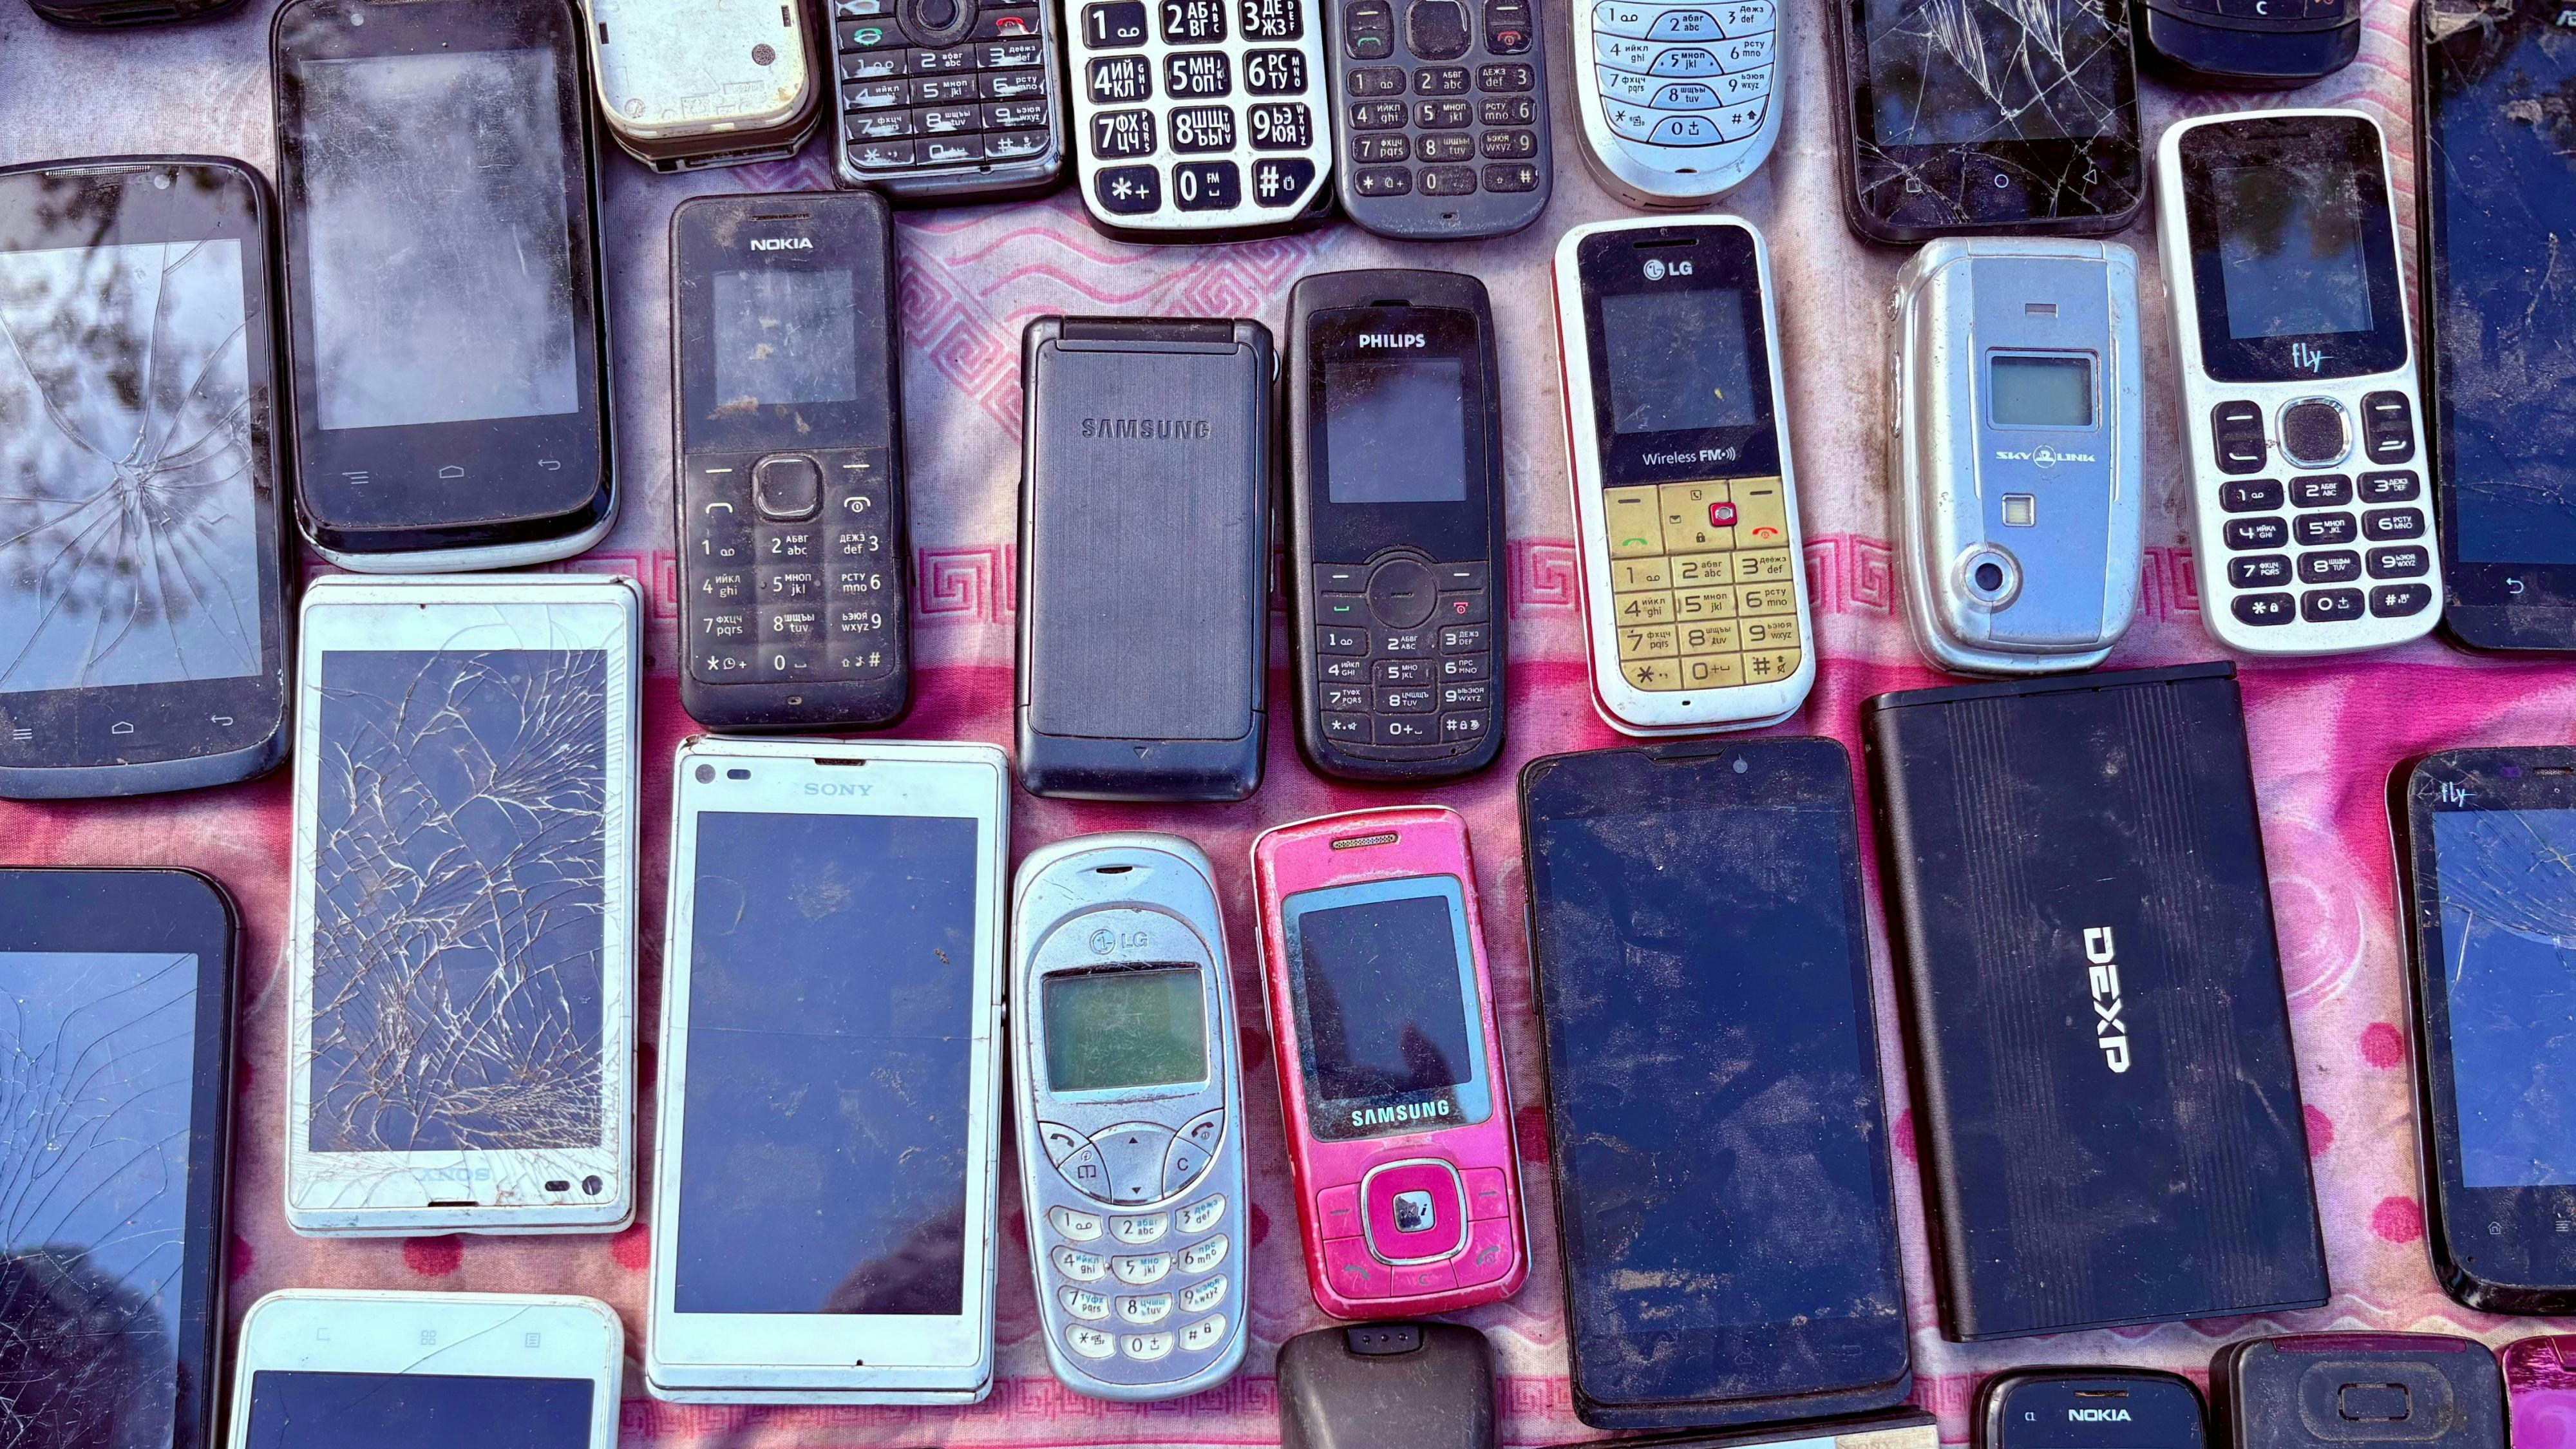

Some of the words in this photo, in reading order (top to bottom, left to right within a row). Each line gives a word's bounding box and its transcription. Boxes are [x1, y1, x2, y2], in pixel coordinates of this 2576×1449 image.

[2256, 1, 2268, 15] C
[1167, 5, 1184, 34] 2
[1244, 3, 1260, 31] 3
[1728, 12, 1736, 24] 3
[1741, 14, 1754, 24] def
[1093, 10, 1106, 39] 1
[1671, 18, 1680, 32] 2
[1684, 23, 1700, 32] abc
[1610, 43, 1621, 57] 4
[1730, 46, 1739, 60] 6
[920, 53, 936, 68] 2
[1631, 53, 1645, 63] ghi
[1671, 54, 1679, 68] 5
[1685, 60, 1697, 70] jkl
[1172, 61, 1188, 90] 5
[1249, 57, 1265, 86] 6
[1517, 69, 1527, 85] 3
[1094, 66, 1112, 95] 4
[1421, 73, 1431, 89] 2
[1444, 80, 1462, 90] abc
[1486, 77, 1503, 86] def
[1610, 74, 1619, 88] 7
[1728, 79, 1738, 92] 9
[923, 83, 938, 98] 5
[1669, 89, 1679, 102] 8
[1357, 107, 1367, 122] 4
[1485, 111, 1509, 120] mno
[1519, 102, 1529, 118] 6
[1253, 110, 1271, 140] 9
[1381, 113, 1398, 124] ghi
[1099, 118, 1114, 148] 7
[1176, 115, 1193, 144] 8
[1671, 122, 1683, 135] 0
[1426, 140, 1435, 156] 8
[1520, 135, 1529, 151] 9
[1380, 147, 1403, 158] pqrs
[1207, 173, 1220, 184] FM
[1426, 174, 1436, 189] 0
[1180, 171, 1197, 201] 0
[750, 237, 813, 251] NOKIA
[1668, 261, 1693, 276] LG
[1359, 334, 1425, 348] PHILIPS
[1082, 419, 1211, 440] SAMSUNG
[1642, 453, 1697, 466] Wireless
[1699, 449, 1722, 462] FM
[1996, 451, 2031, 460] SKY
[2057, 453, 2096, 462] LINK
[2306, 484, 2319, 497] 2
[2239, 527, 2255, 539] 4
[2309, 522, 2324, 535] 5
[772, 538, 782, 553] 2
[844, 544, 863, 554] def
[869, 536, 879, 551] 3
[787, 546, 807, 556] abc
[1682, 562, 1699, 579] 2
[1704, 569, 1721, 577] abc
[1742, 558, 1758, 574] 3
[1767, 564, 1783, 574] def
[2243, 565, 2255, 577] 7
[2313, 560, 2328, 573] 8
[703, 579, 713, 594] 4
[773, 577, 782, 592] 5
[842, 583, 867, 593] mno
[870, 574, 880, 589] 6
[791, 583, 806, 596] jkl
[1685, 596, 1701, 612] 5
[1746, 591, 1762, 608] 6
[1767, 598, 1788, 606] mno
[2317, 598, 2333, 611] 0
[1625, 600, 1641, 617] 4
[1647, 606, 1662, 616] ghi
[1710, 601, 1723, 613] jkl
[703, 618, 714, 633] 7
[773, 616, 784, 632] 8
[842, 622, 869, 632] wxyz
[871, 614, 882, 629] 9
[717, 625, 743, 636] pqrs
[1689, 629, 1705, 646] 8
[1749, 625, 1766, 641] 9
[1388, 638, 1399, 650] 2
[1445, 634, 1456, 645] 3
[1627, 634, 1643, 651] 7
[775, 655, 785, 670] 0
[1445, 662, 1457, 674] 6
[1329, 665, 1340, 676] 4
[1388, 667, 1399, 679] 5
[1692, 662, 1709, 680] 0
[1330, 692, 1341, 704] 7
[1389, 695, 1400, 706] 8
[1445, 690, 1457, 702] 9
[1390, 723, 1401, 735] 0
[804, 782, 874, 796] SONY
[1121, 931, 1148, 949] LG
[2083, 926, 2131, 1073] DEXP
[1351, 1099, 1449, 1126] SAMSUNG
[1177, 1157, 1189, 1171] C
[1122, 1220, 1133, 1234] 2
[1126, 1260, 1135, 1274] 5
[1143, 1265, 1155, 1276] jkl
[1419, 1274, 1429, 1285] C
[1128, 1300, 1137, 1314] 8
[1132, 1338, 1142, 1352] 0
[2068, 1408, 2132, 1421] NOKIA
